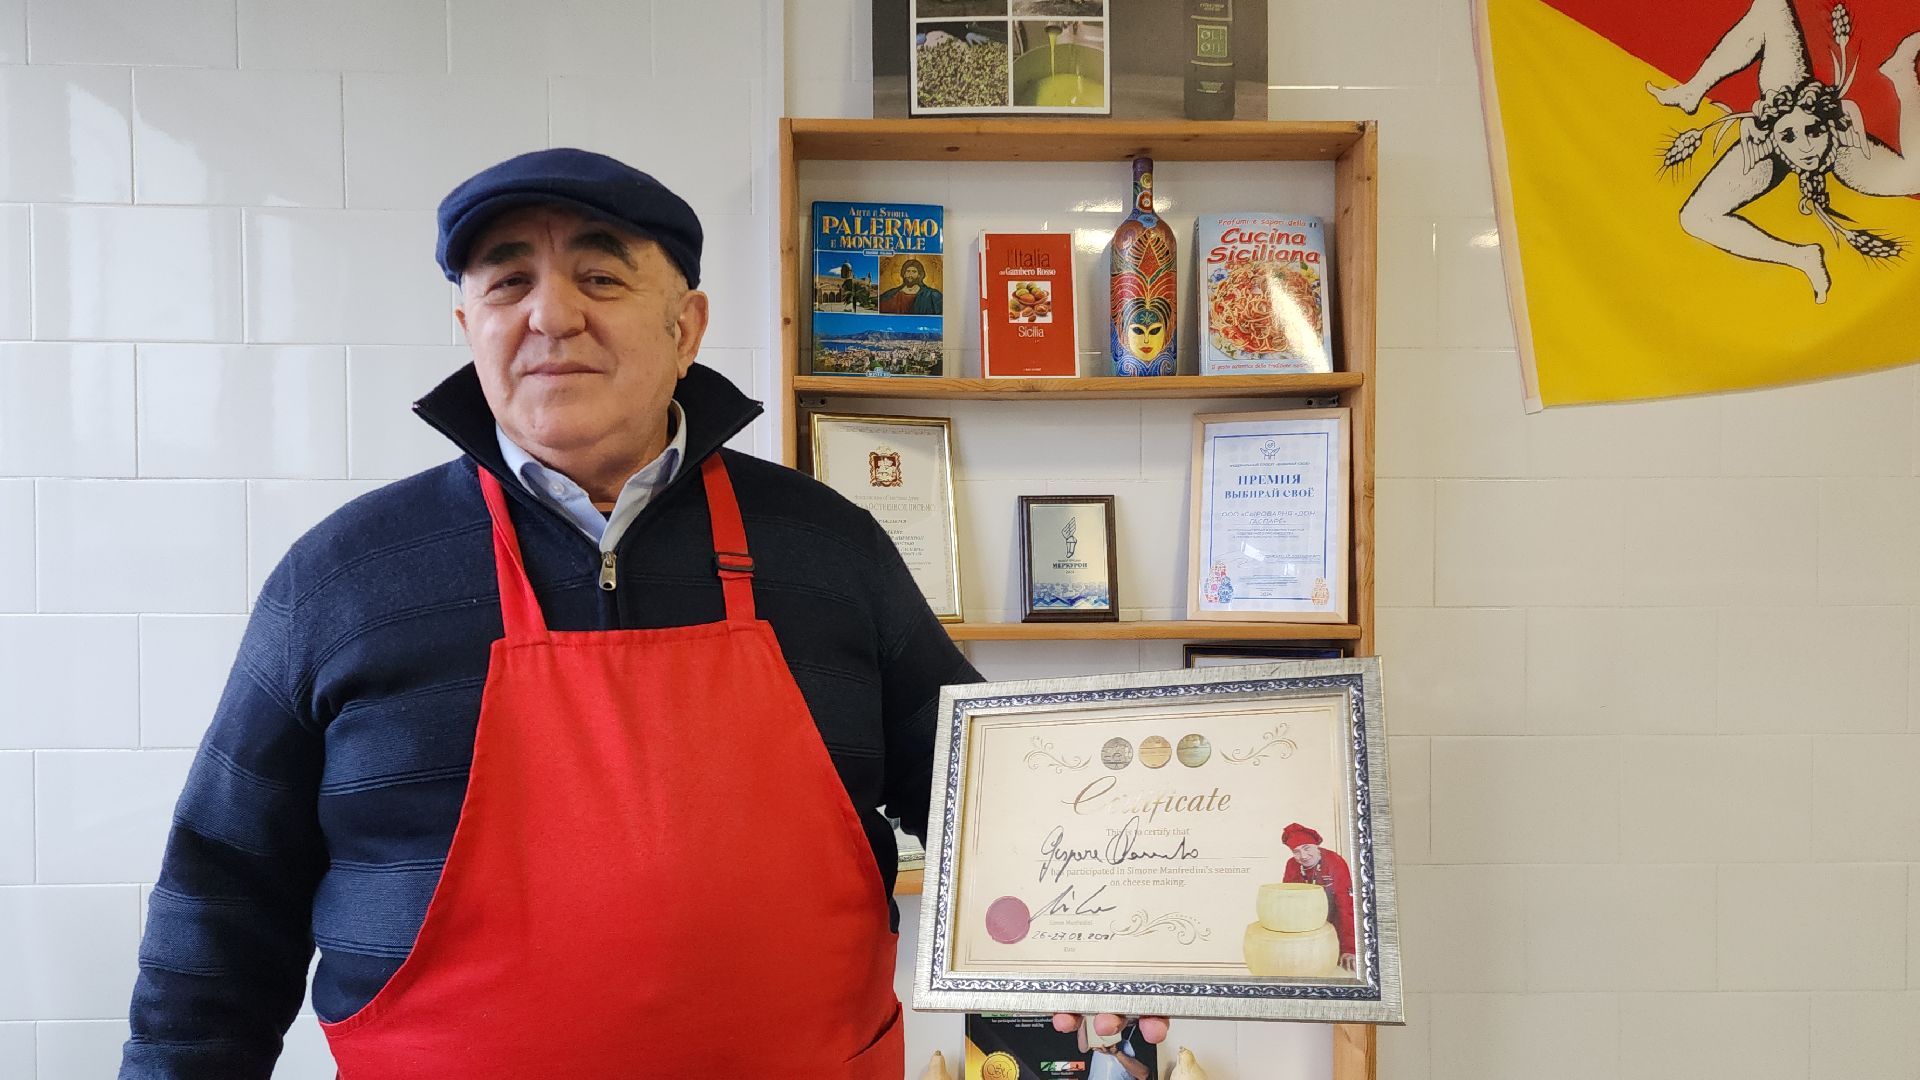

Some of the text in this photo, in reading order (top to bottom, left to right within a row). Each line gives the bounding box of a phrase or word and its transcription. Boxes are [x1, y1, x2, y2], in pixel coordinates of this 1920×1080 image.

[822, 216, 938, 237] PALERMO
[830, 236, 926, 250] E MONREALE
[1220, 228, 1306, 246] Cucina
[1207, 244, 1320, 264] Siciliana
[1006, 267, 1036, 276] Gambero
[1036, 268, 1056, 276] Rosso
[1018, 326, 1044, 338] Sicilia
[1238, 474, 1300, 485] ПРЕМИЯ
[1225, 487, 1314, 499] ВЫБИРАЙ СВОЁ
[1106, 828, 1122, 836] This
[1144, 828, 1170, 837] certify
[1172, 828, 1190, 836] that
[1066, 868, 1114, 878] participated
[1117, 867, 1124, 875] in
[1127, 866, 1158, 875] Simone
[1160, 865, 1212, 874] Manfredini's
[1214, 866, 1250, 874] seminar
[1122, 878, 1150, 886] cheese
[1152, 878, 1187, 888] making.
